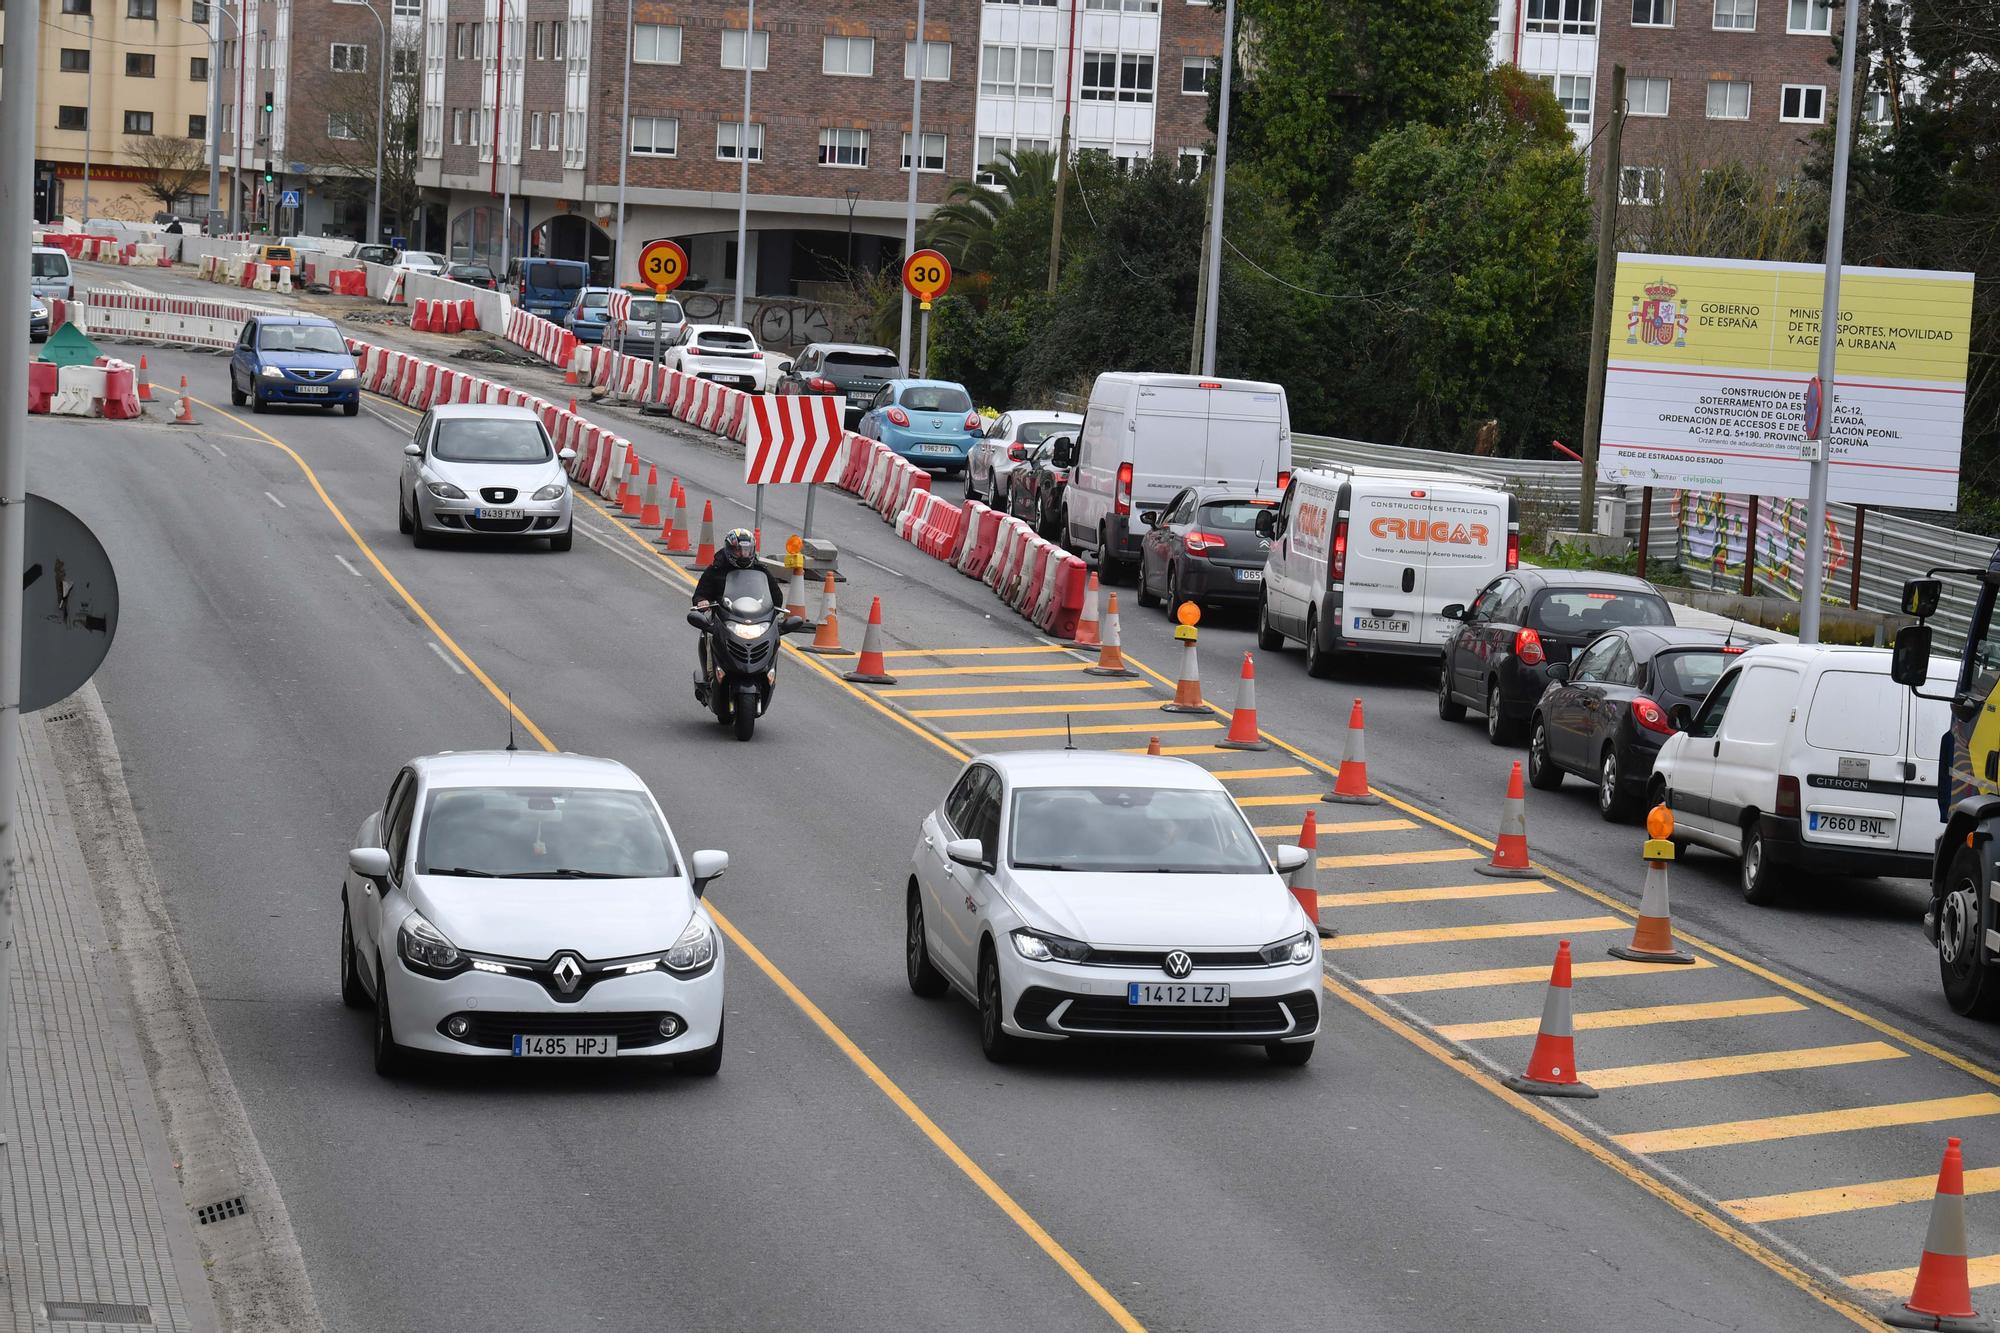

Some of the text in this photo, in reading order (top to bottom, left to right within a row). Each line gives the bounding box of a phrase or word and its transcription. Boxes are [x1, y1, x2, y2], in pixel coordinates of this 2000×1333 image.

[650, 257, 676, 274] 30
[914, 266, 940, 283] 30
[1701, 303, 1760, 316] GOBIERNO
[1789, 308, 1853, 321] MINISIO
[1700, 316, 1758, 329] DE ESPAÑA
[1788, 322, 1803, 332] DE
[1889, 328, 1953, 341] MOVILIDAD
[1787, 335, 1896, 351] Y AGEA URBANA
[1721, 387, 1786, 400] CONSTRUCIÓN
[1788, 391, 1801, 400] DE
[1694, 406, 1759, 418] CONSTRUCIÓN
[1761, 411, 1773, 419] DE
[1699, 396, 1774, 409] SOTERRAMENTO
[1776, 401, 1788, 409] DA
[1834, 406, 1863, 416] AC-12,
[1658, 413, 1717, 426] ORDENACIÓN
[1719, 418, 1731, 427] DE
[1733, 420, 1777, 430] ACCESOS
[1787, 424, 1799, 432] DE
[1688, 426, 1869, 447] AC-12 P.Q. 5+190. PROVINCI CORUÑA
[1698, 436, 1729, 445] Orzamento
[1618, 450, 1636, 458] REDE
[1648, 453, 1684, 461] ESTRADAS
[1697, 457, 1724, 465] ESTADO
[1682, 474, 1723, 485] civisglobal
[481, 510, 521, 519] 9439 FYX
[1371, 501, 1488, 516] CONSTRUCCIONES METALICAS
[1369, 517, 1489, 546] CRUGAR
[1399, 548, 1426, 556] Aluminio
[1452, 552, 1483, 560] Inoxidable
[1361, 619, 1408, 631] 8451 GFW
[1820, 815, 1886, 835] 7660 BNL
[1144, 986, 1225, 1003] 1412 LZJ
[525, 1038, 608, 1055] 1485 HPJ
